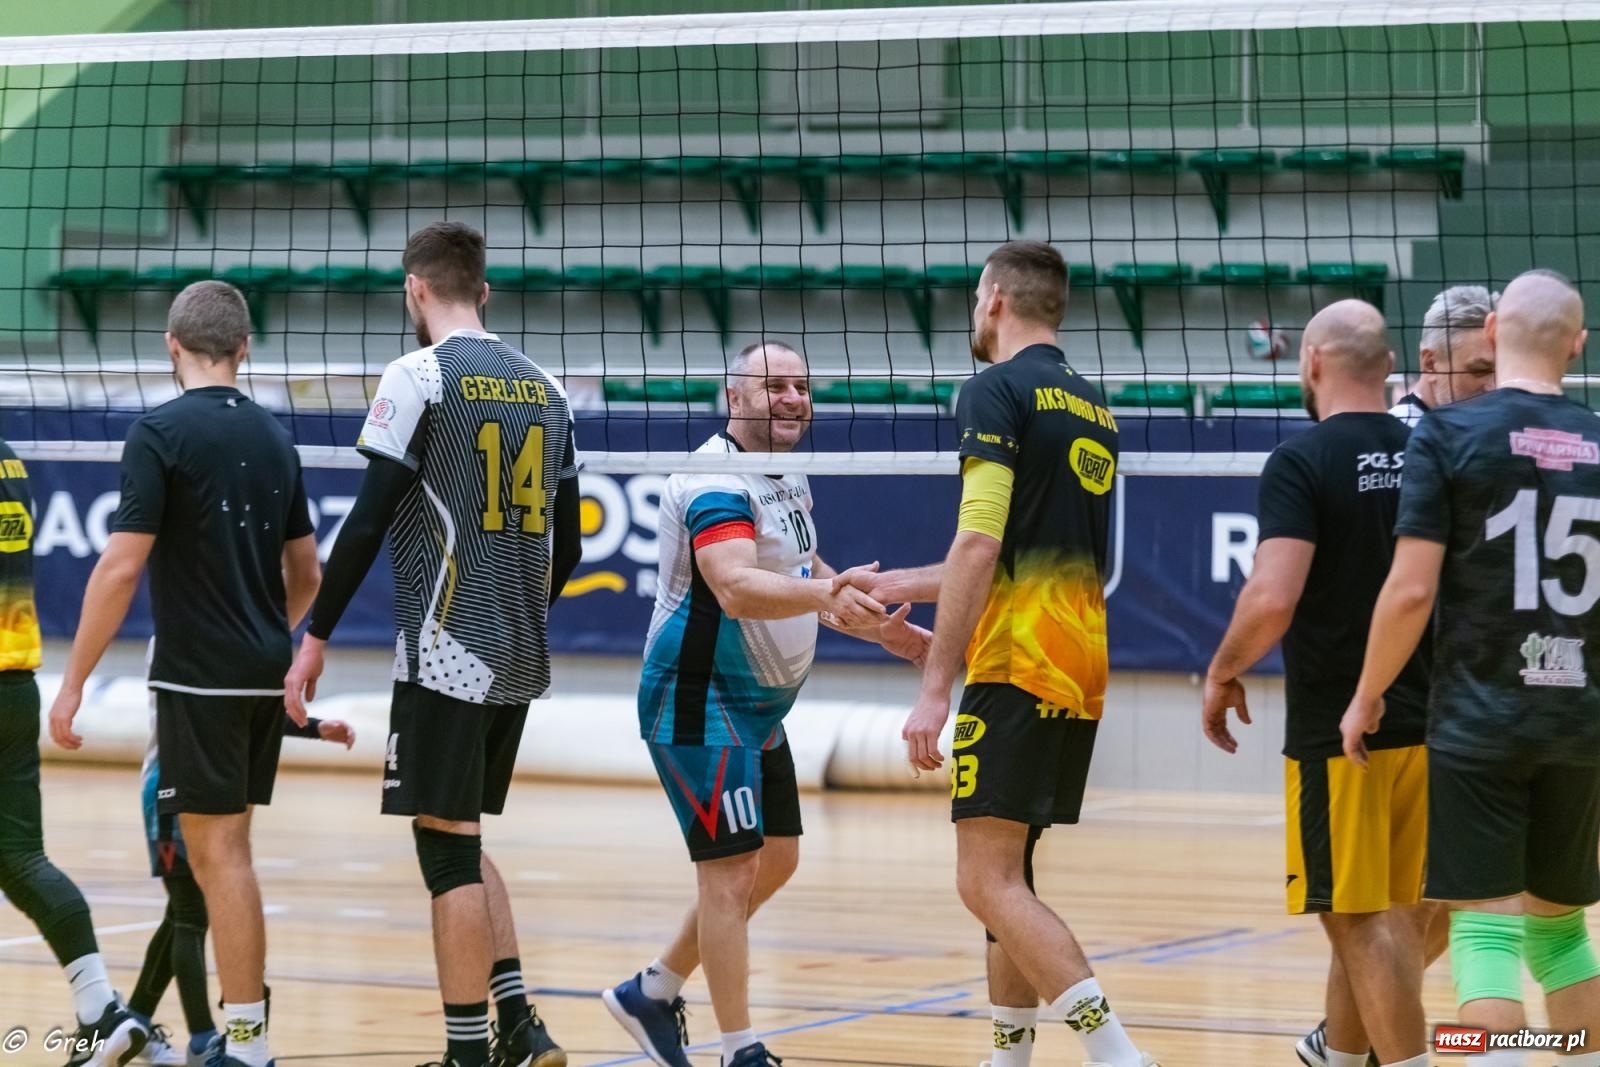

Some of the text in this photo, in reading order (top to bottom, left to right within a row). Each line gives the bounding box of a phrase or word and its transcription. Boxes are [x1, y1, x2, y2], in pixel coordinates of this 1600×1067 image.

[460, 375, 549, 407] GERLICH
[1035, 387, 1066, 411] AKS
[1063, 391, 1096, 422] NORD
[477, 422, 547, 534] 14
[788, 510, 811, 554] 10
[1485, 489, 1600, 616] 15
[722, 786, 757, 834] 10
